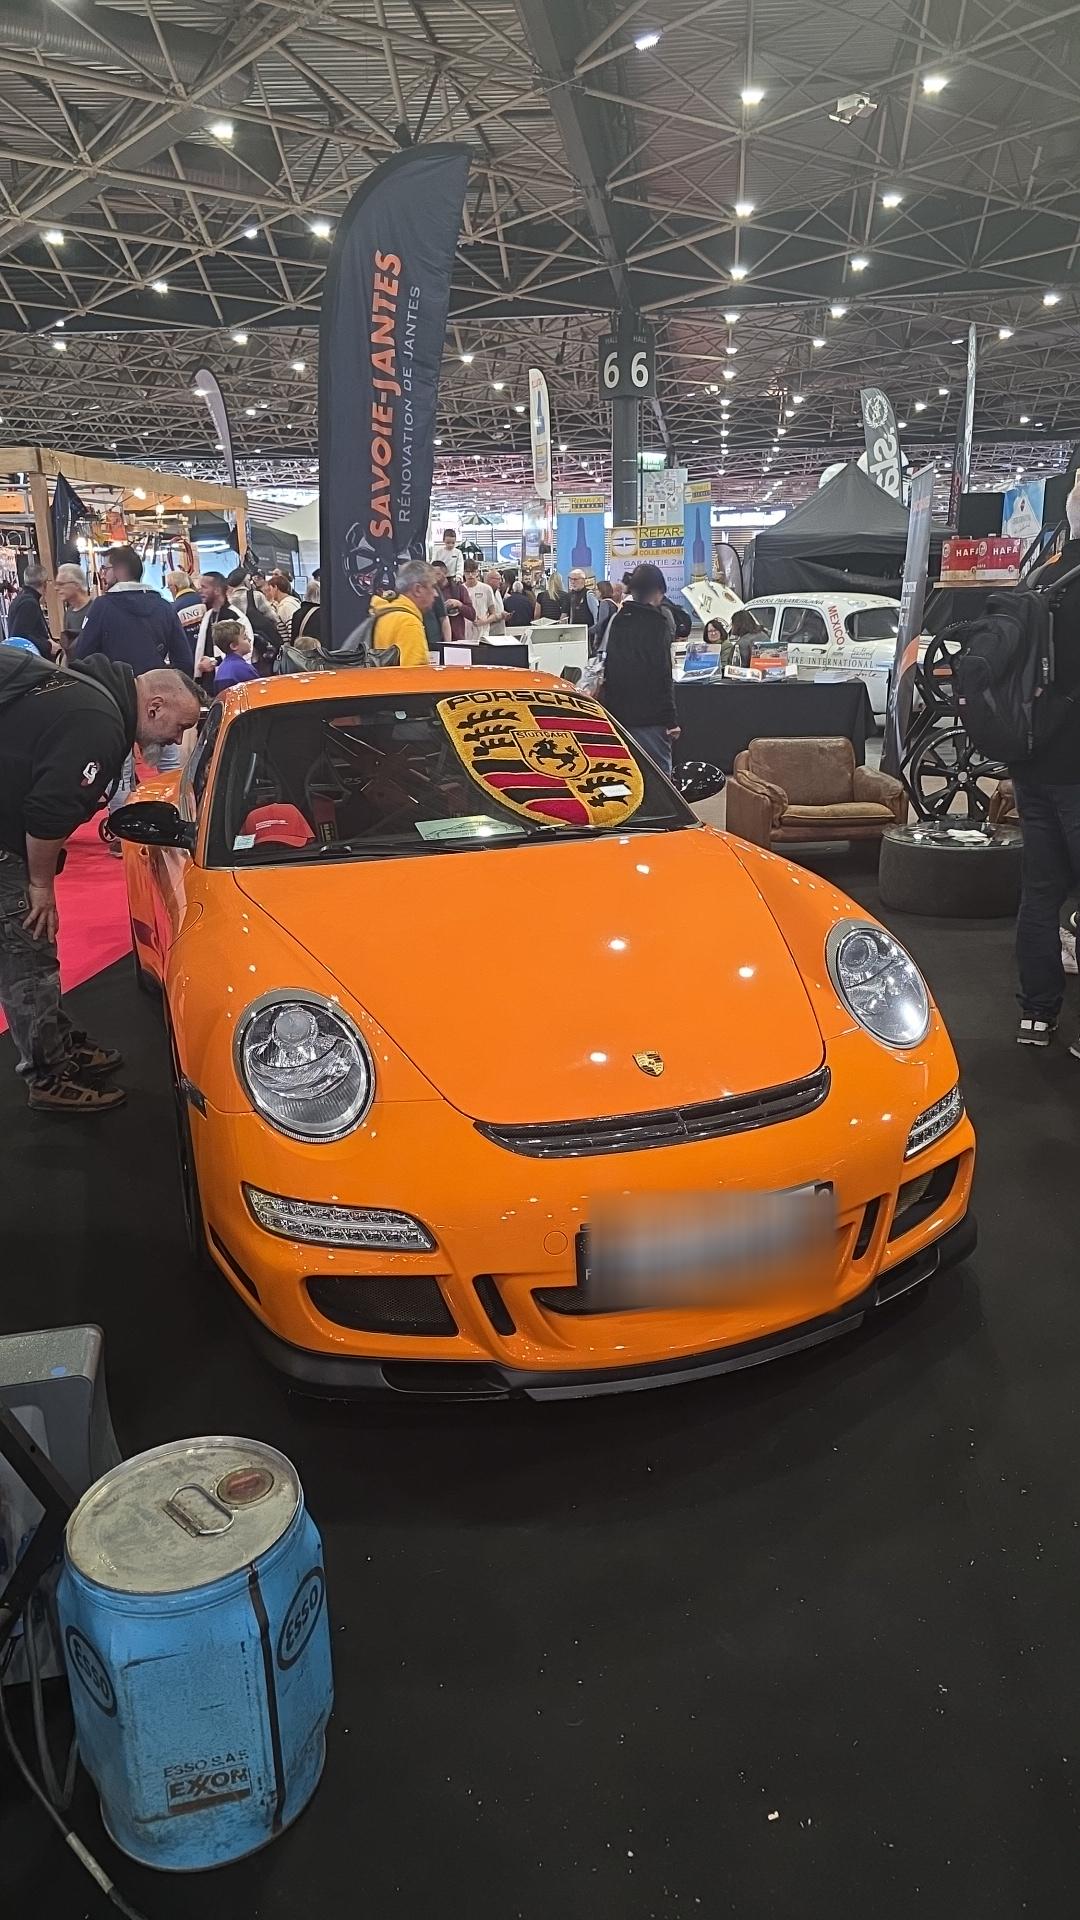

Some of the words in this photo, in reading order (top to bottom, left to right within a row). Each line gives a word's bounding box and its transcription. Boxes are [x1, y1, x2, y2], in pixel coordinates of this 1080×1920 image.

[403, 285, 420, 361] JANTES
[403, 366, 412, 392] DE
[603, 351, 620, 389] 6
[631, 351, 649, 388] 6
[370, 249, 401, 540] SAVOIE-JANTES
[397, 399, 414, 523] RÉNOVATION
[993, 546, 1019, 556] HAFA
[827, 605, 845, 646] MEXICO
[808, 657, 874, 668] INTERNATIONAL
[446, 690, 600, 711] PORSCHE
[517, 731, 569, 739] STUTTGART
[163, 1759, 208, 1778] ESSO
[168, 1767, 249, 1799] EXXON
